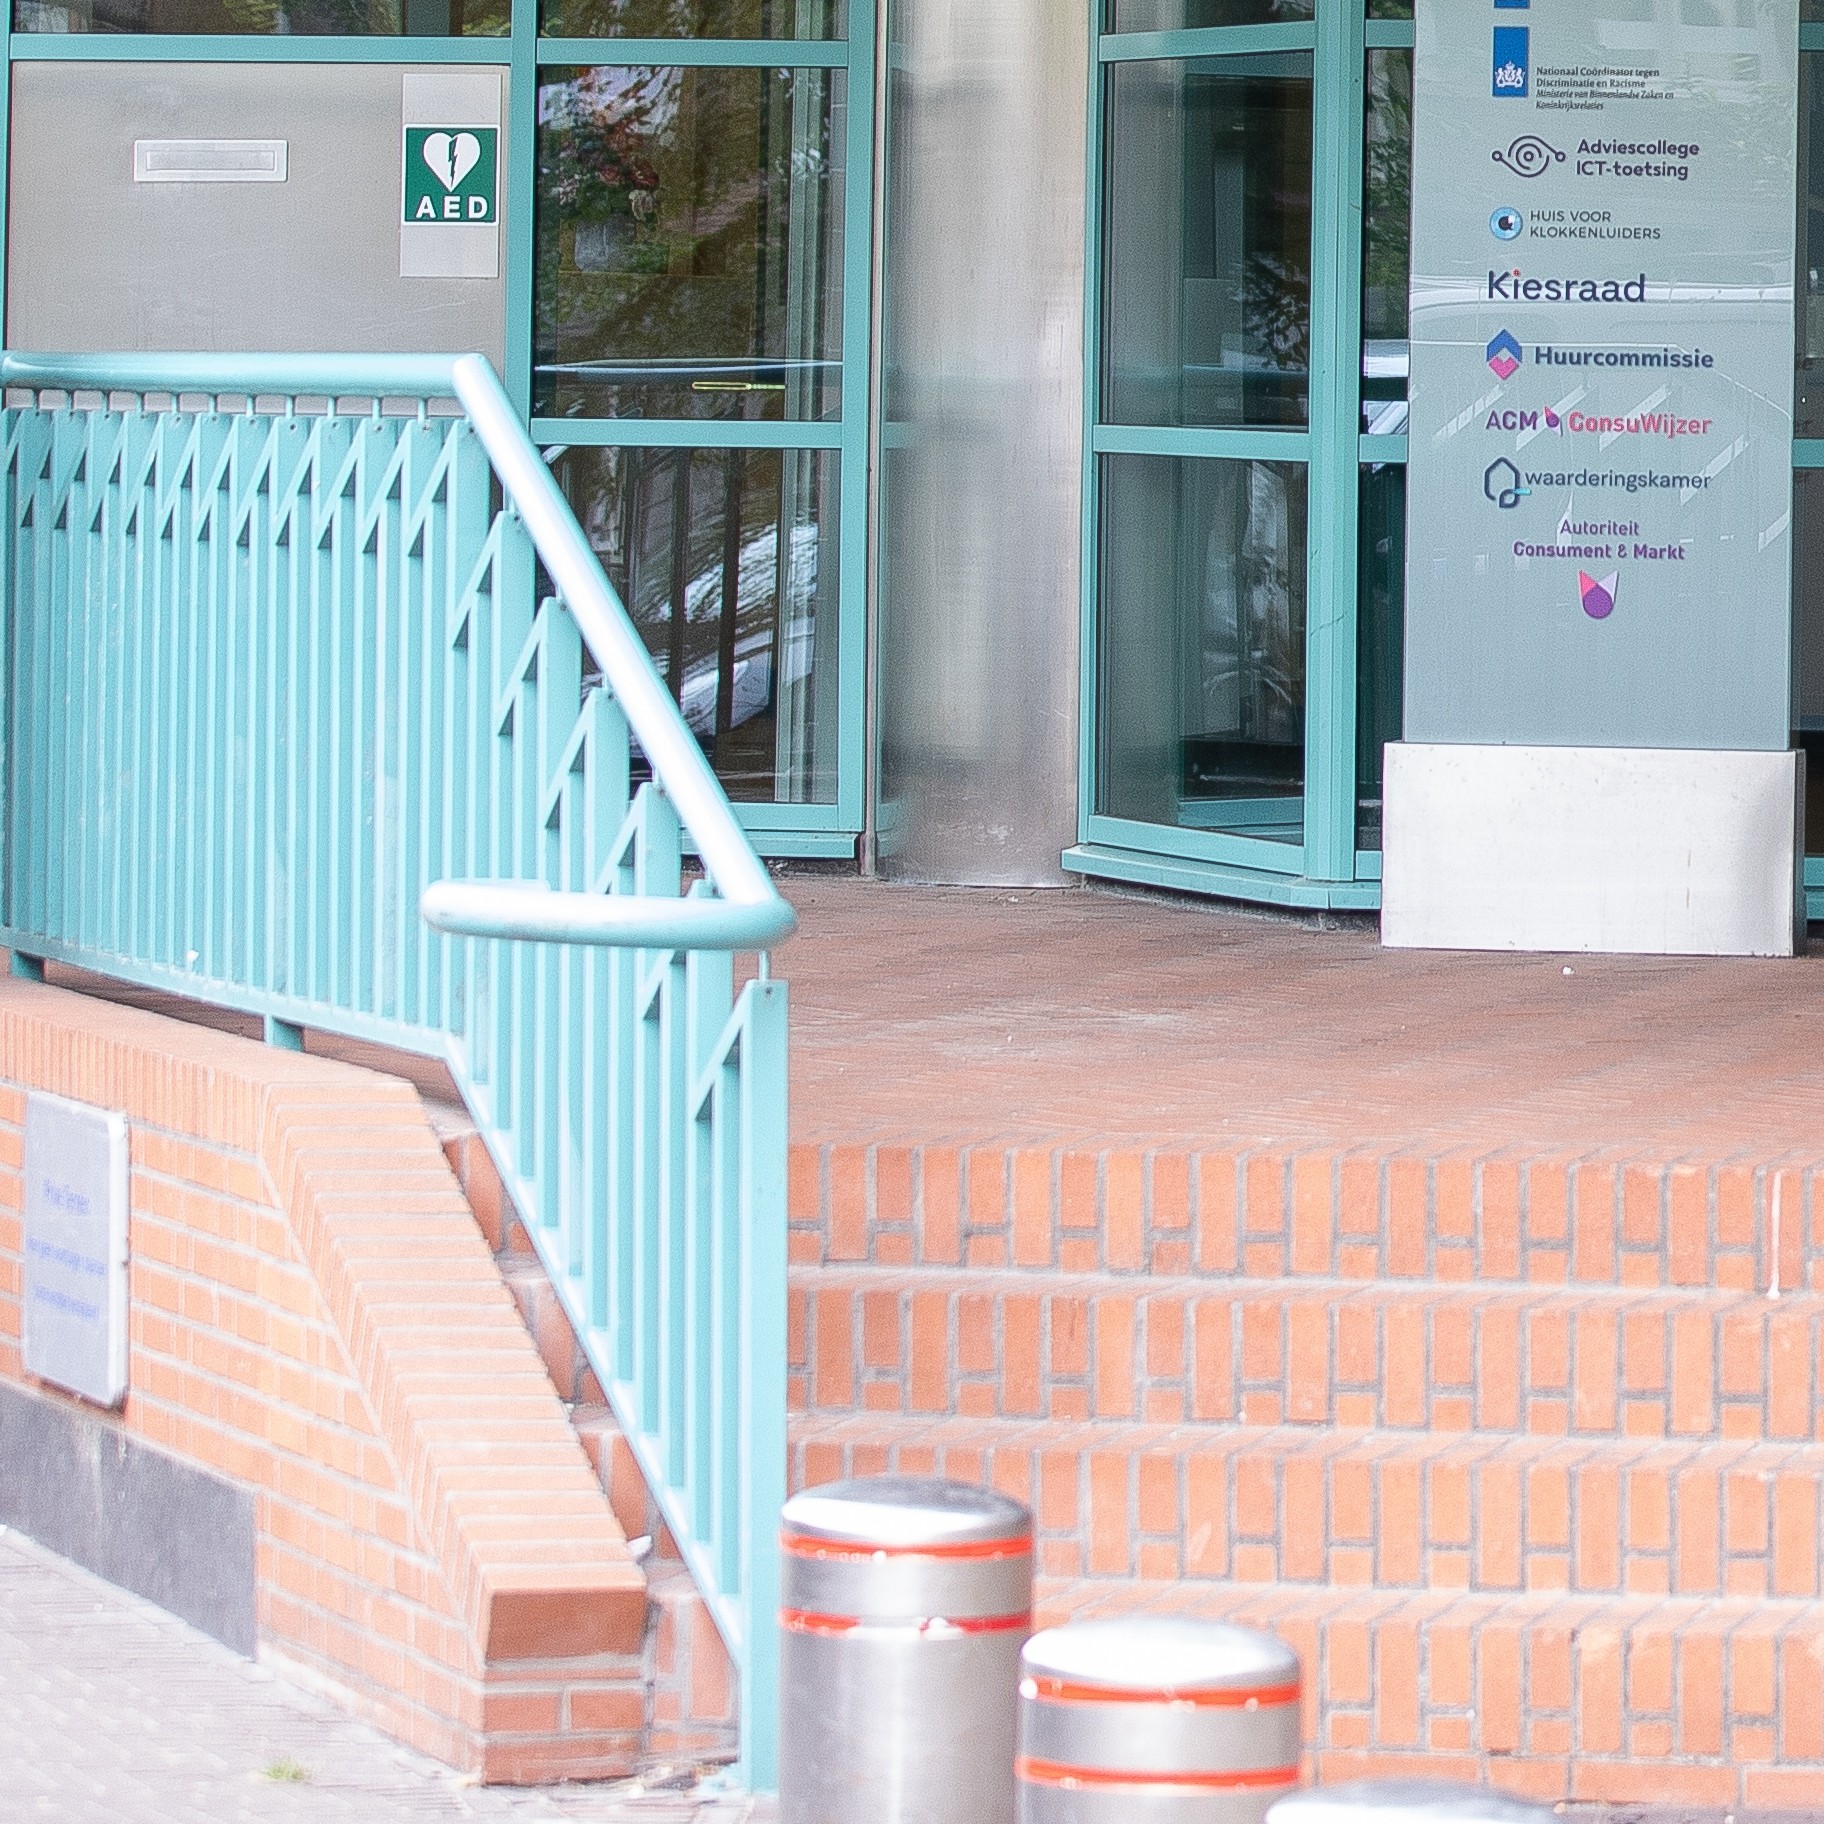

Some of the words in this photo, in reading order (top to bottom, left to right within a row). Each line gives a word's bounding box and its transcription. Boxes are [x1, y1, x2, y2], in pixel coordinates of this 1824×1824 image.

[1536, 66, 1579, 77] Nationaal
[1635, 68, 1660, 79] tegen
[1536, 78, 1595, 88] Discriminatie
[1609, 79, 1646, 89] Racisme
[1577, 138, 1700, 160] Adviescollege
[1576, 160, 1689, 182] ICT-toetsing
[415, 195, 489, 220] AED
[1530, 210, 1565, 223] HUIS
[1570, 210, 1611, 223] VOOR
[1529, 225, 1661, 240] KLOKKENLUIDERS
[1488, 269, 1647, 303] Kiesraad
[1534, 346, 1714, 369] Huurcommissie
[1486, 409, 1538, 431] ACM
[1568, 411, 1712, 439] ConsuWijzer
[1525, 468, 1711, 492] waarderingskamer
[1560, 520, 1640, 536] Autoriteit
[1513, 542, 1611, 559] Consument
[1617, 544, 1628, 559] &
[1633, 544, 1685, 560] Markt
